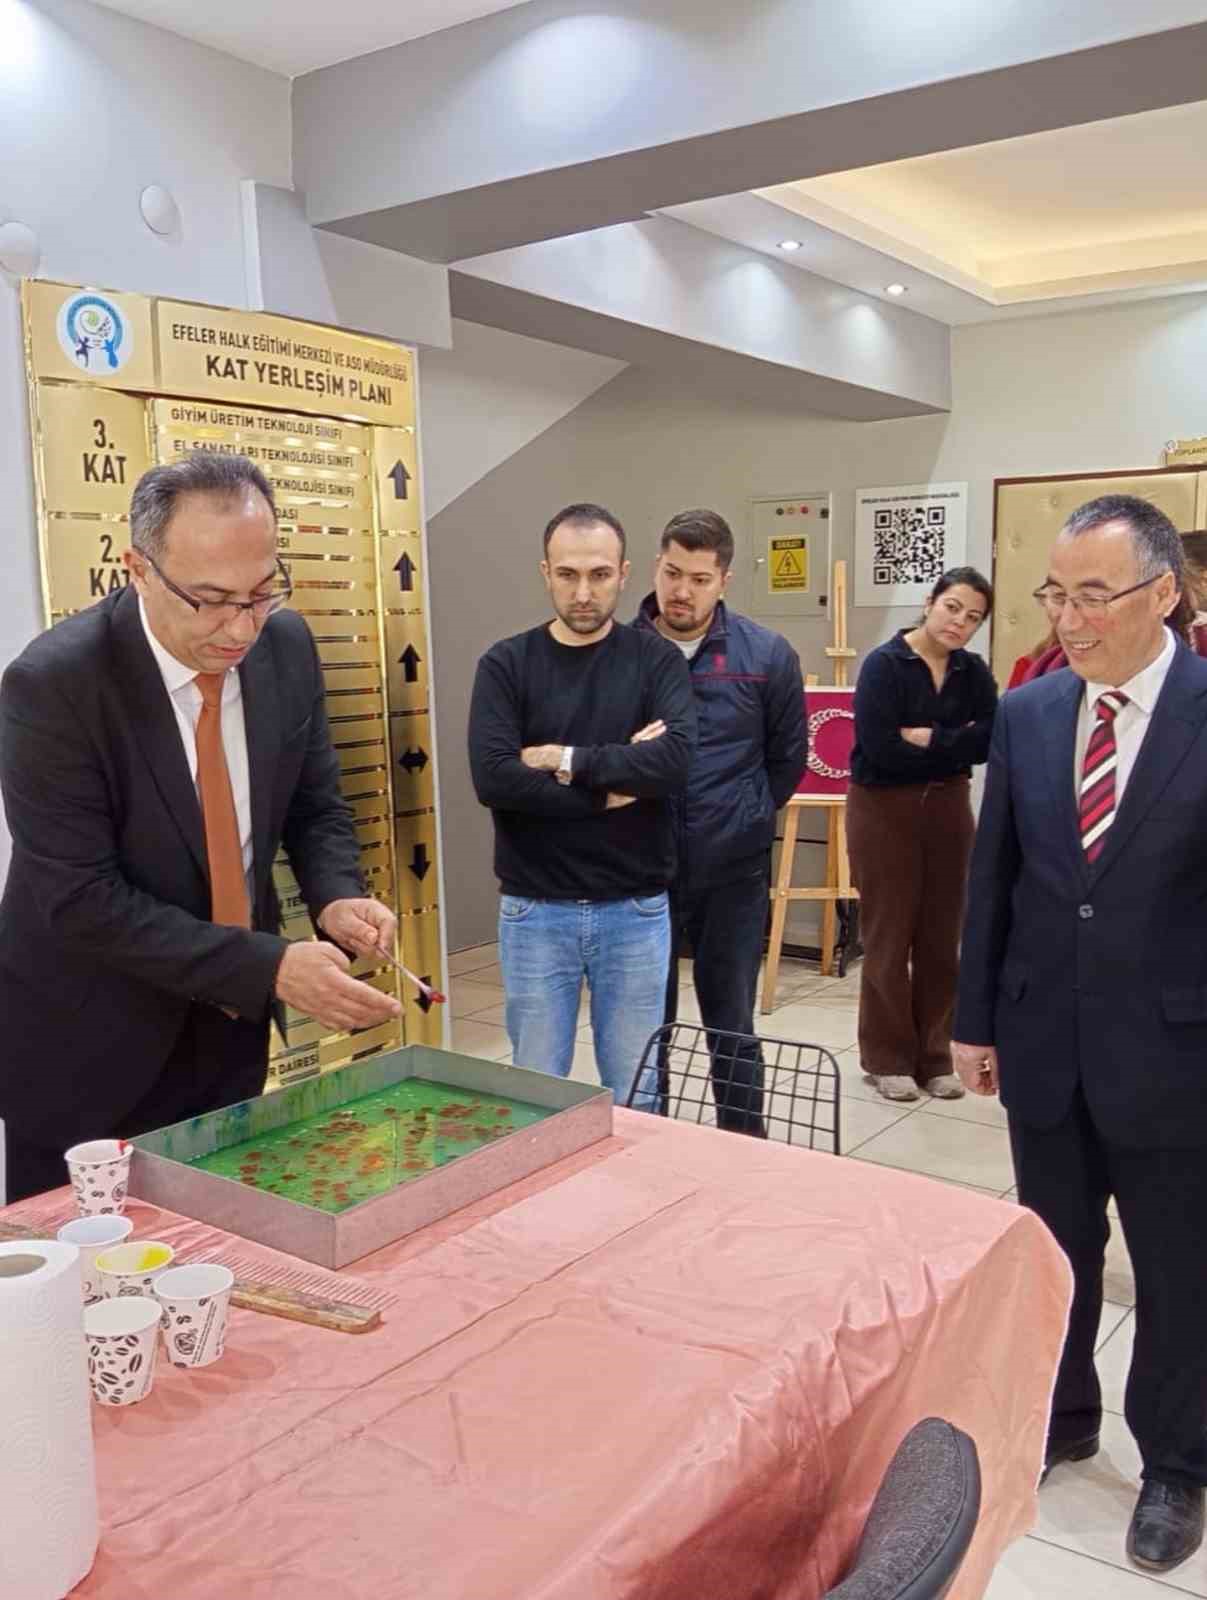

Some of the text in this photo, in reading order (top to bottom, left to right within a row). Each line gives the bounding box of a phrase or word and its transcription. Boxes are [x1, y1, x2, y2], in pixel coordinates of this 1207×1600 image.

[172, 323, 217, 344] EFELER
[219, 330, 252, 350] HALK
[293, 342, 332, 365] MERKEZİ
[333, 352, 345, 367] VE
[206, 354, 393, 406] KAT YERLEŞİM PLANI
[171, 405, 208, 423] GİYİM
[93, 418, 115, 449] 3.
[83, 453, 127, 484] KAT
[269, 477, 327, 494] EKNOLOJİSİ
[100, 534, 121, 563] 2.
